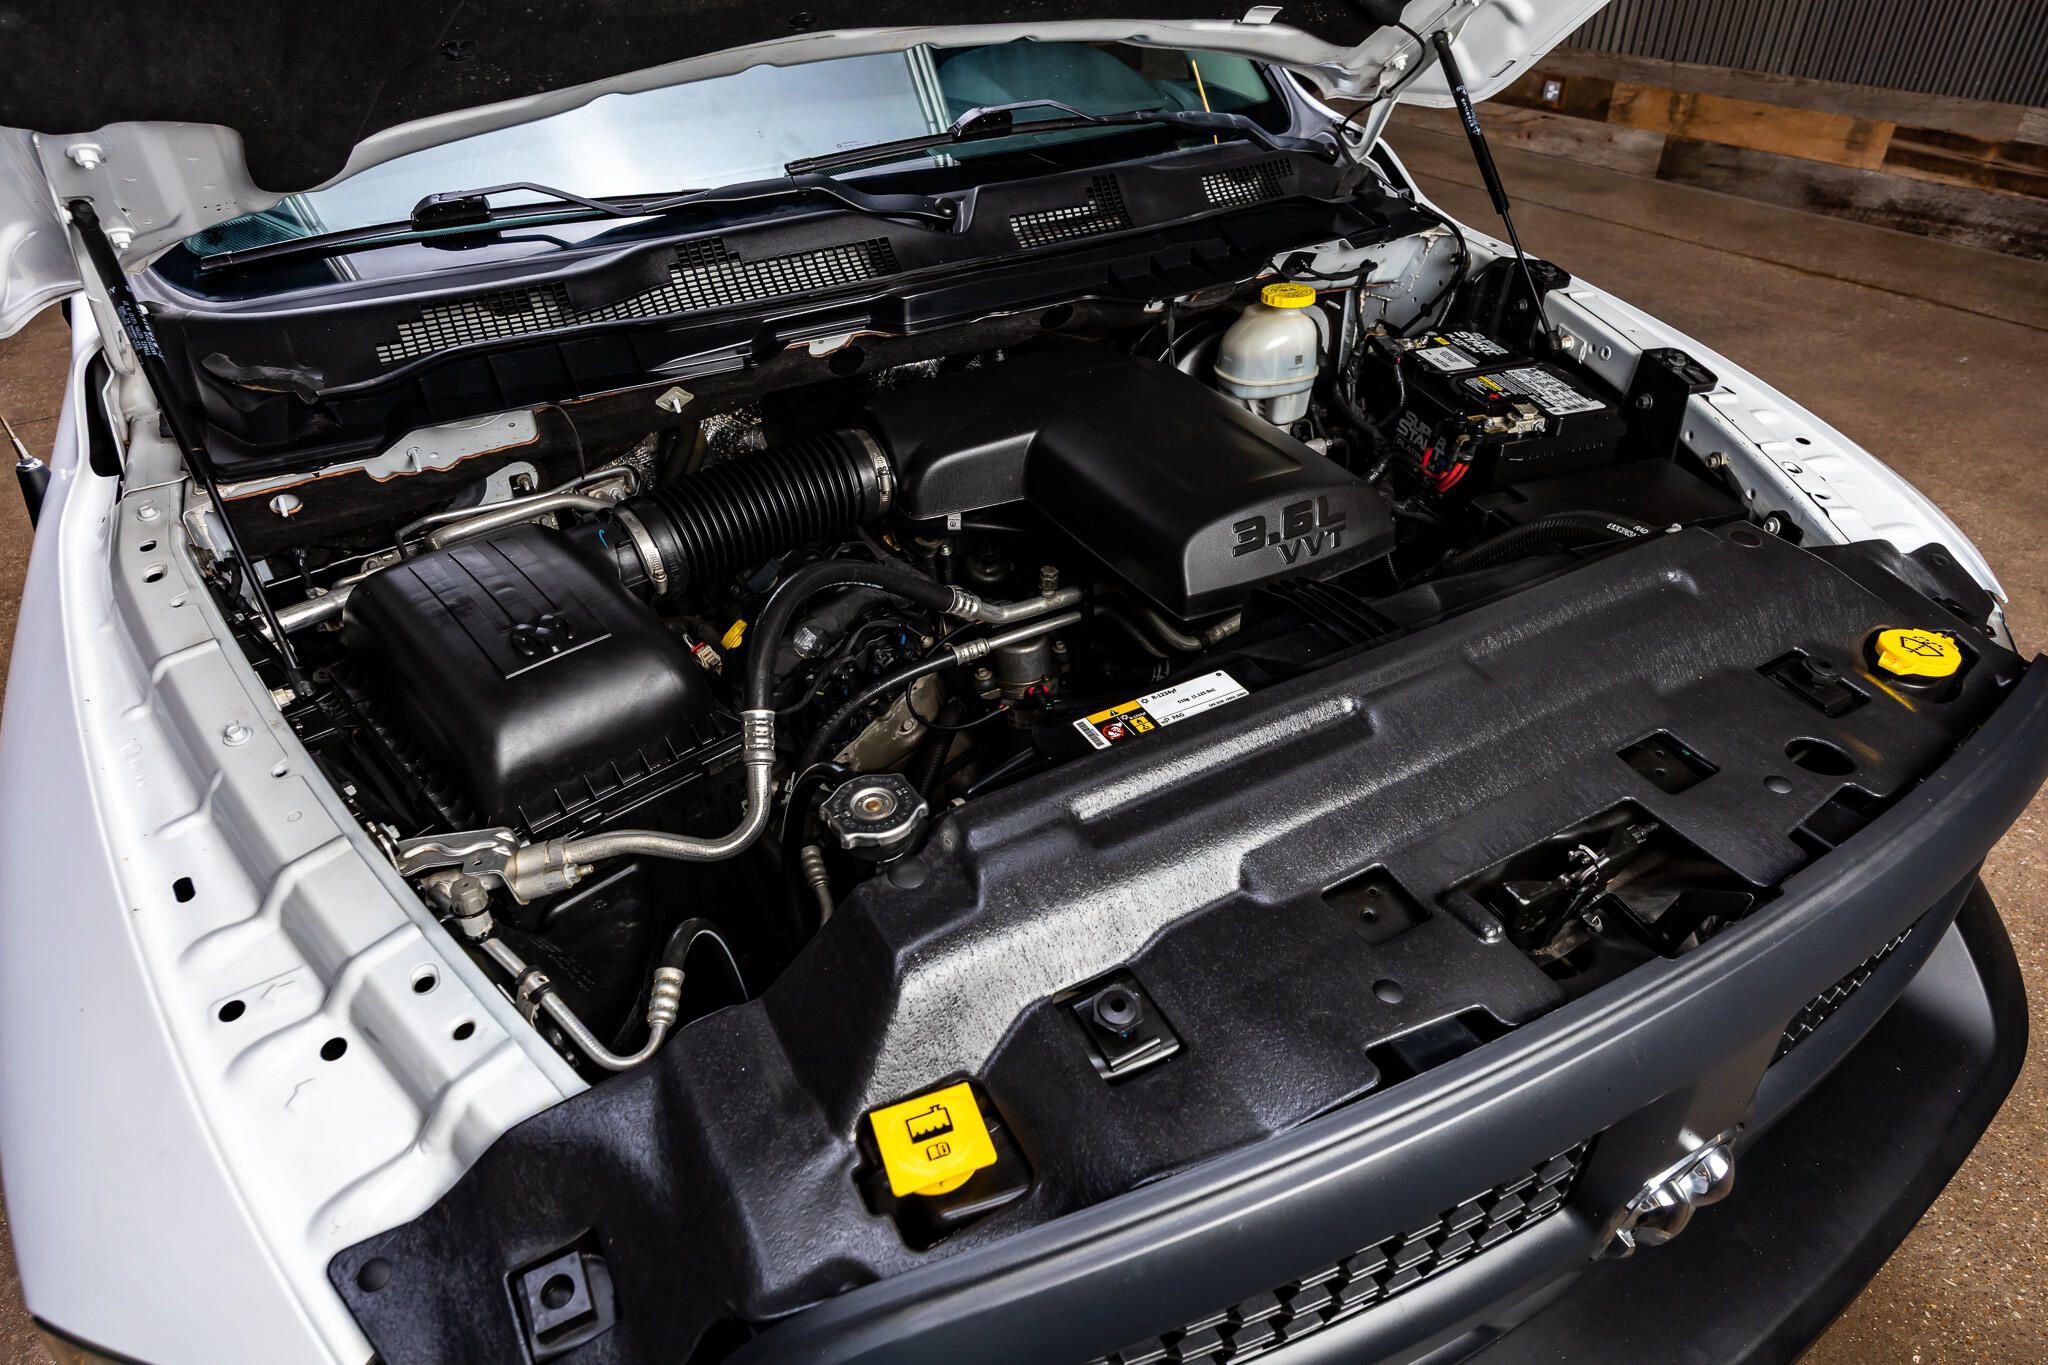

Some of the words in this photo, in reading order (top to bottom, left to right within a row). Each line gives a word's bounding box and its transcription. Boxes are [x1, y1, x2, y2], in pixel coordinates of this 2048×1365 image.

[1453, 331, 1495, 356] START
[1405, 409, 1447, 450] SUPR
[1232, 495, 1346, 558] 3.6L
[1277, 528, 1342, 565] VVT
[1151, 688, 1177, 702] R-1234yf
[1171, 711, 1185, 721] PAG
